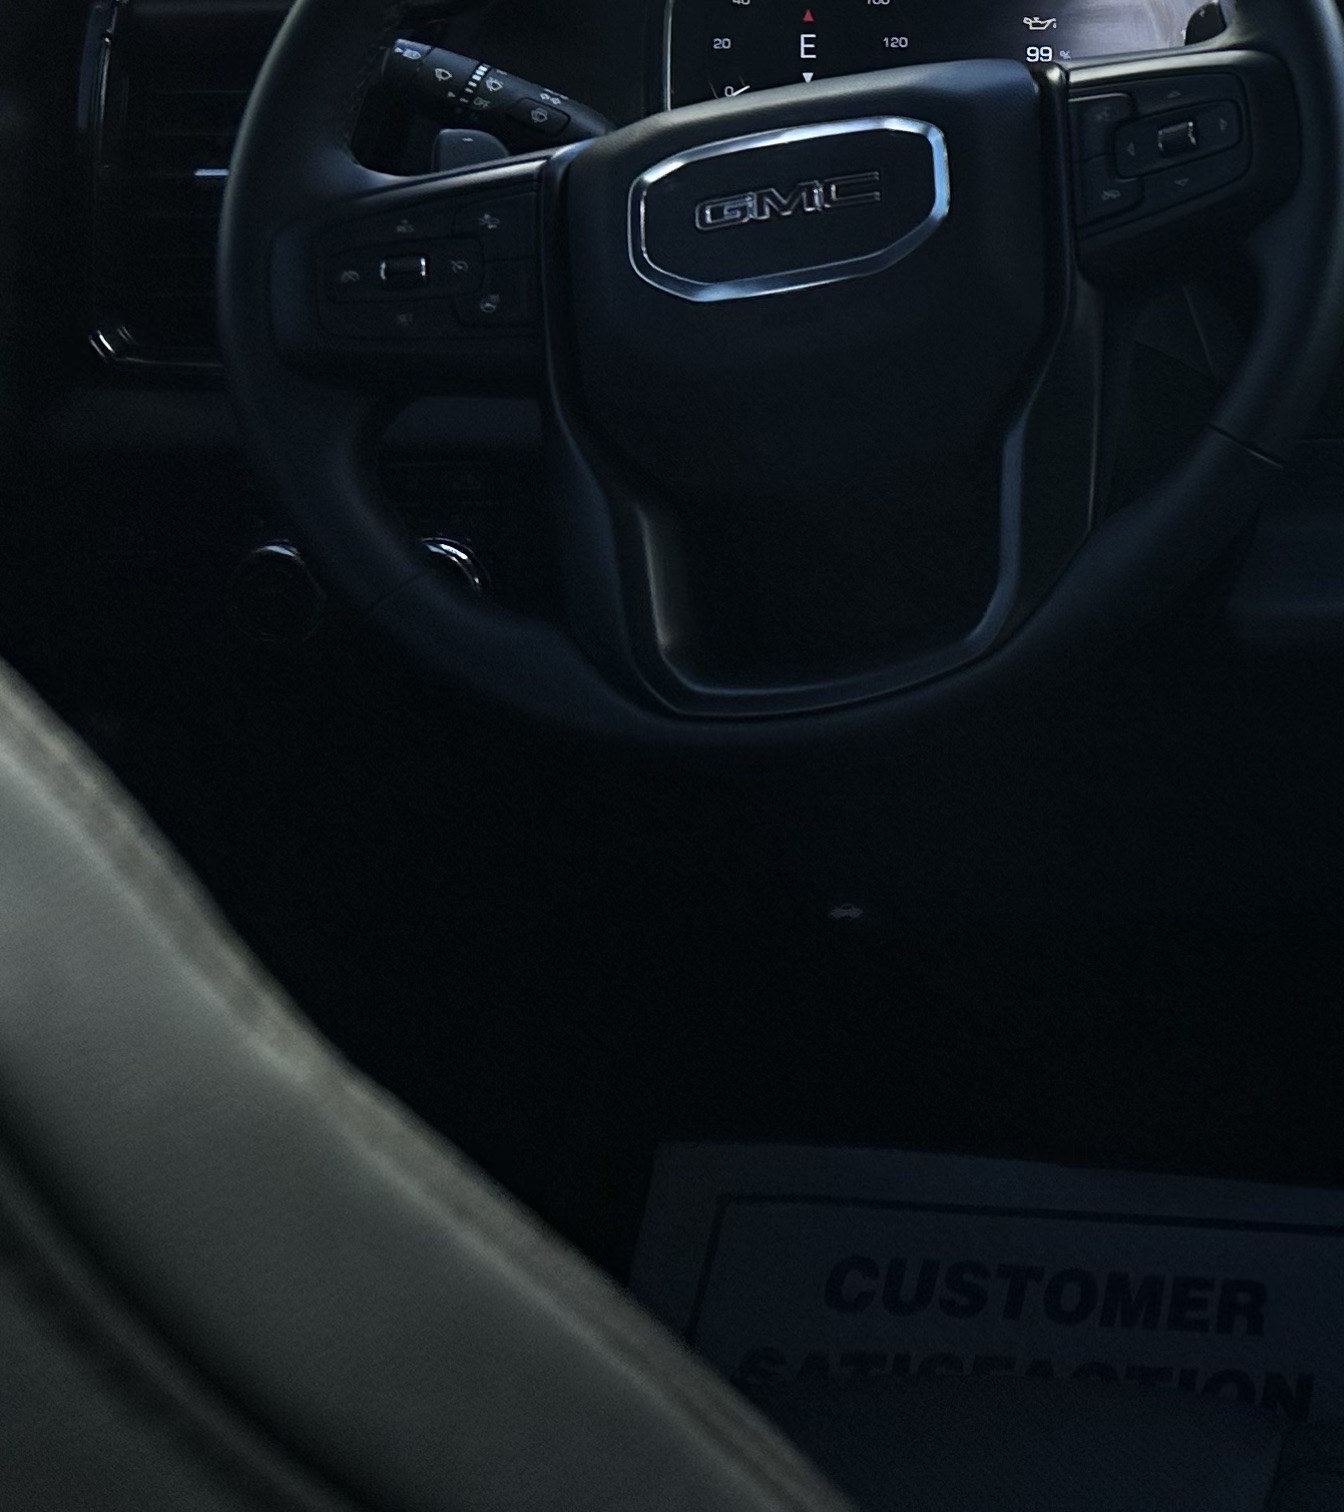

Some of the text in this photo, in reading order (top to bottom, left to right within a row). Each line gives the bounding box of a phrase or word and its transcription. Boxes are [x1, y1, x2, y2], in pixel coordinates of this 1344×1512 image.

[713, 38, 732, 49] 20
[800, 33, 817, 59] E
[883, 37, 909, 49] 120
[1026, 46, 1053, 63] 99
[694, 170, 881, 232] GMC
[824, 1254, 1268, 1337] CUSTOMER
